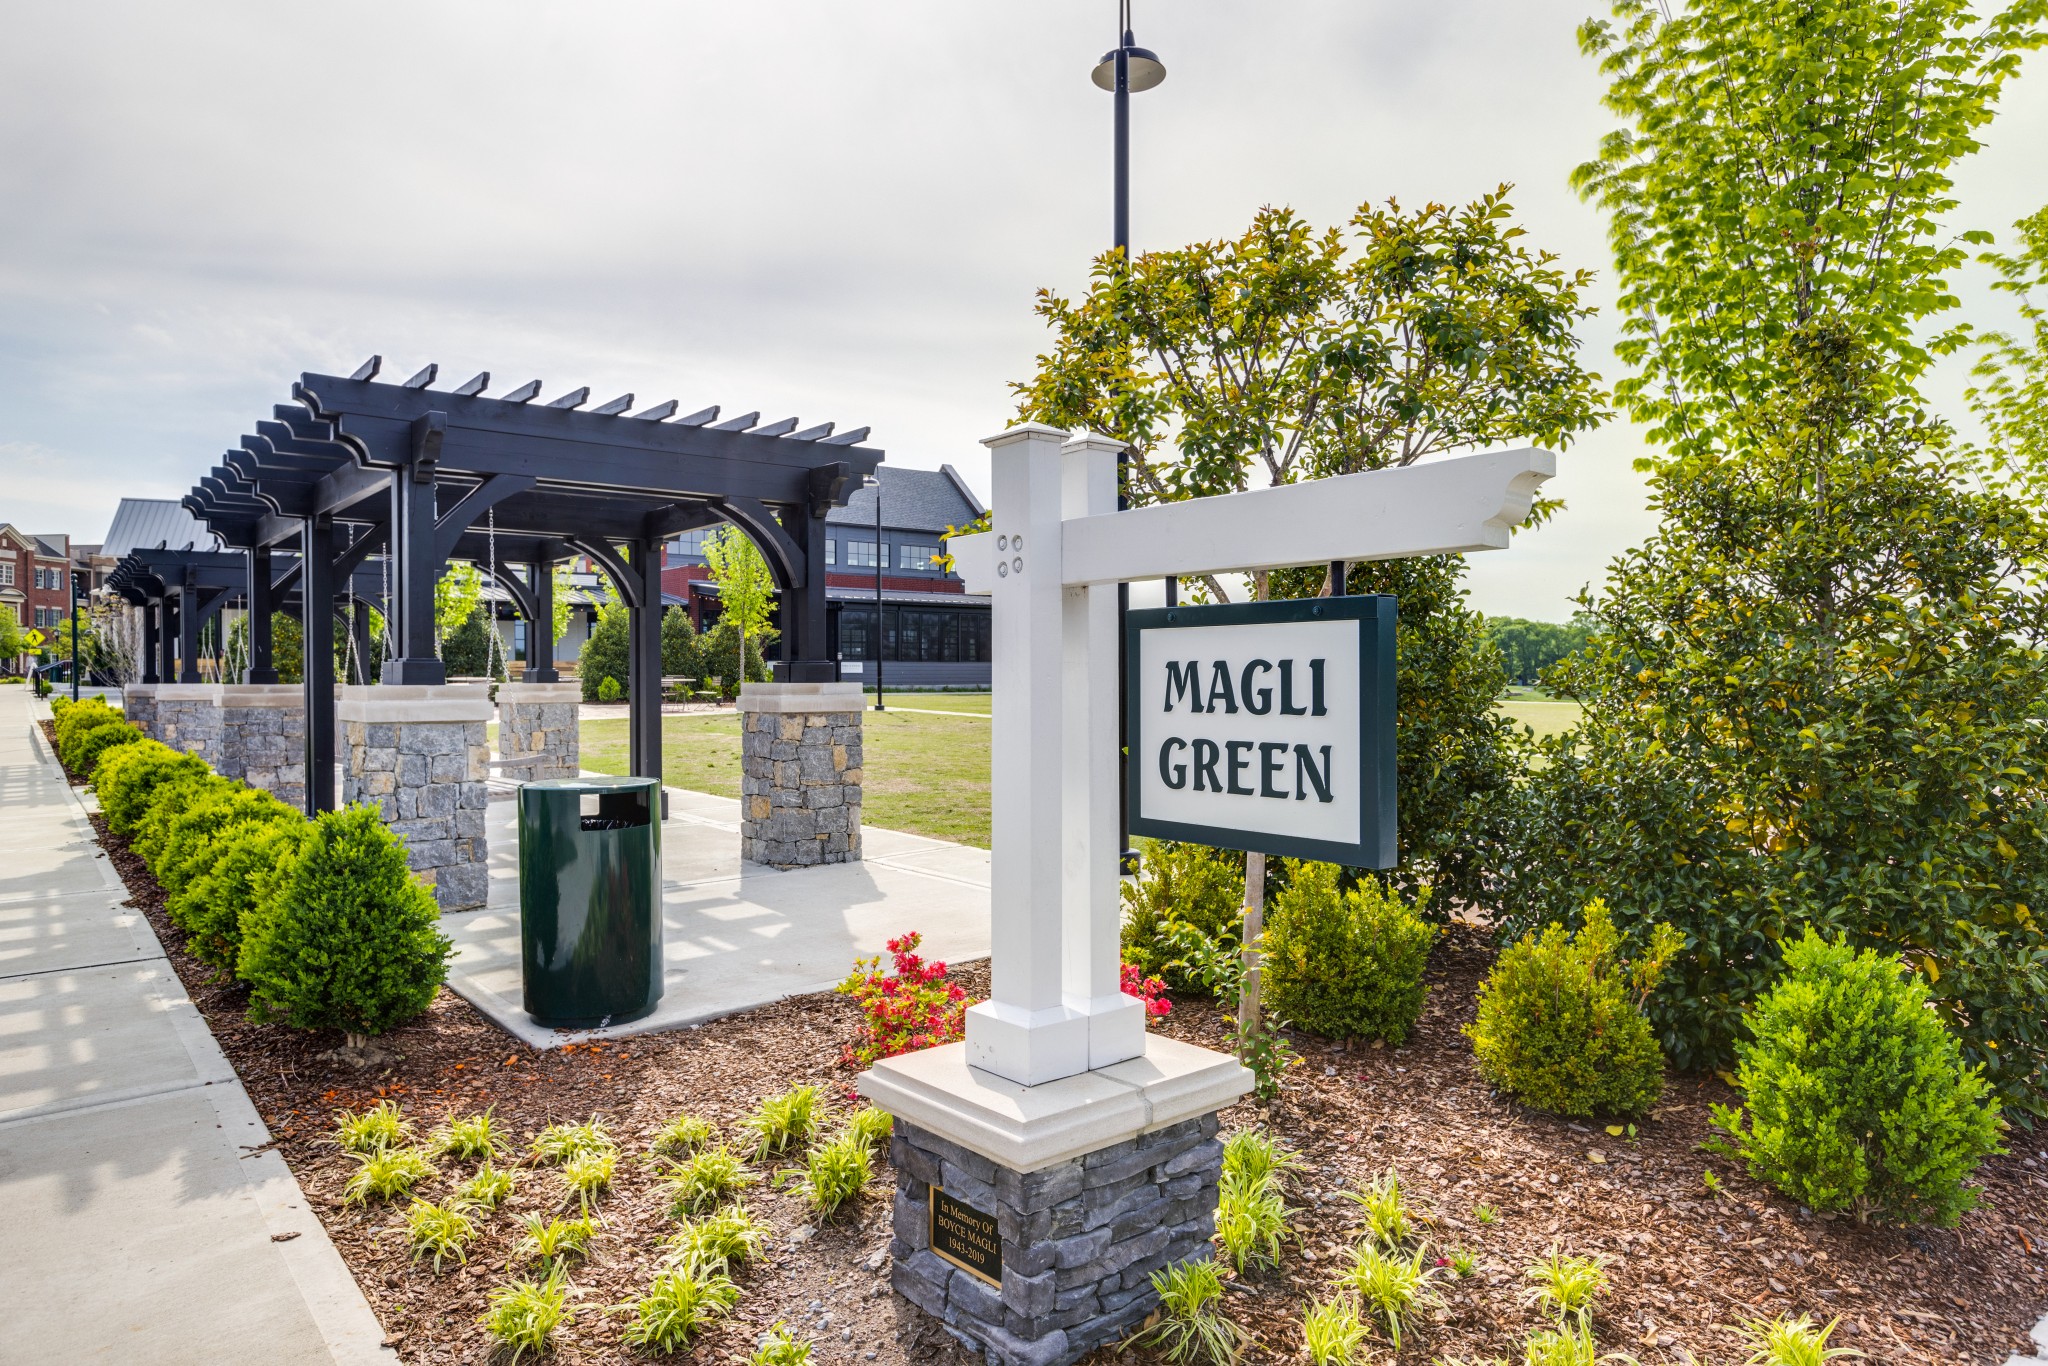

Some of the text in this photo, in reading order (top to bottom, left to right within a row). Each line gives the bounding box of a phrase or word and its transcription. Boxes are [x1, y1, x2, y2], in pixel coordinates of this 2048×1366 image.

[1163, 658, 1328, 717] MAGLI
[1158, 736, 1335, 804] GREEN
[938, 1215, 997, 1255] BOYCE MAGLI
[941, 1200, 994, 1236] In Memory Of
[949, 1236, 985, 1265] 1943-2019
